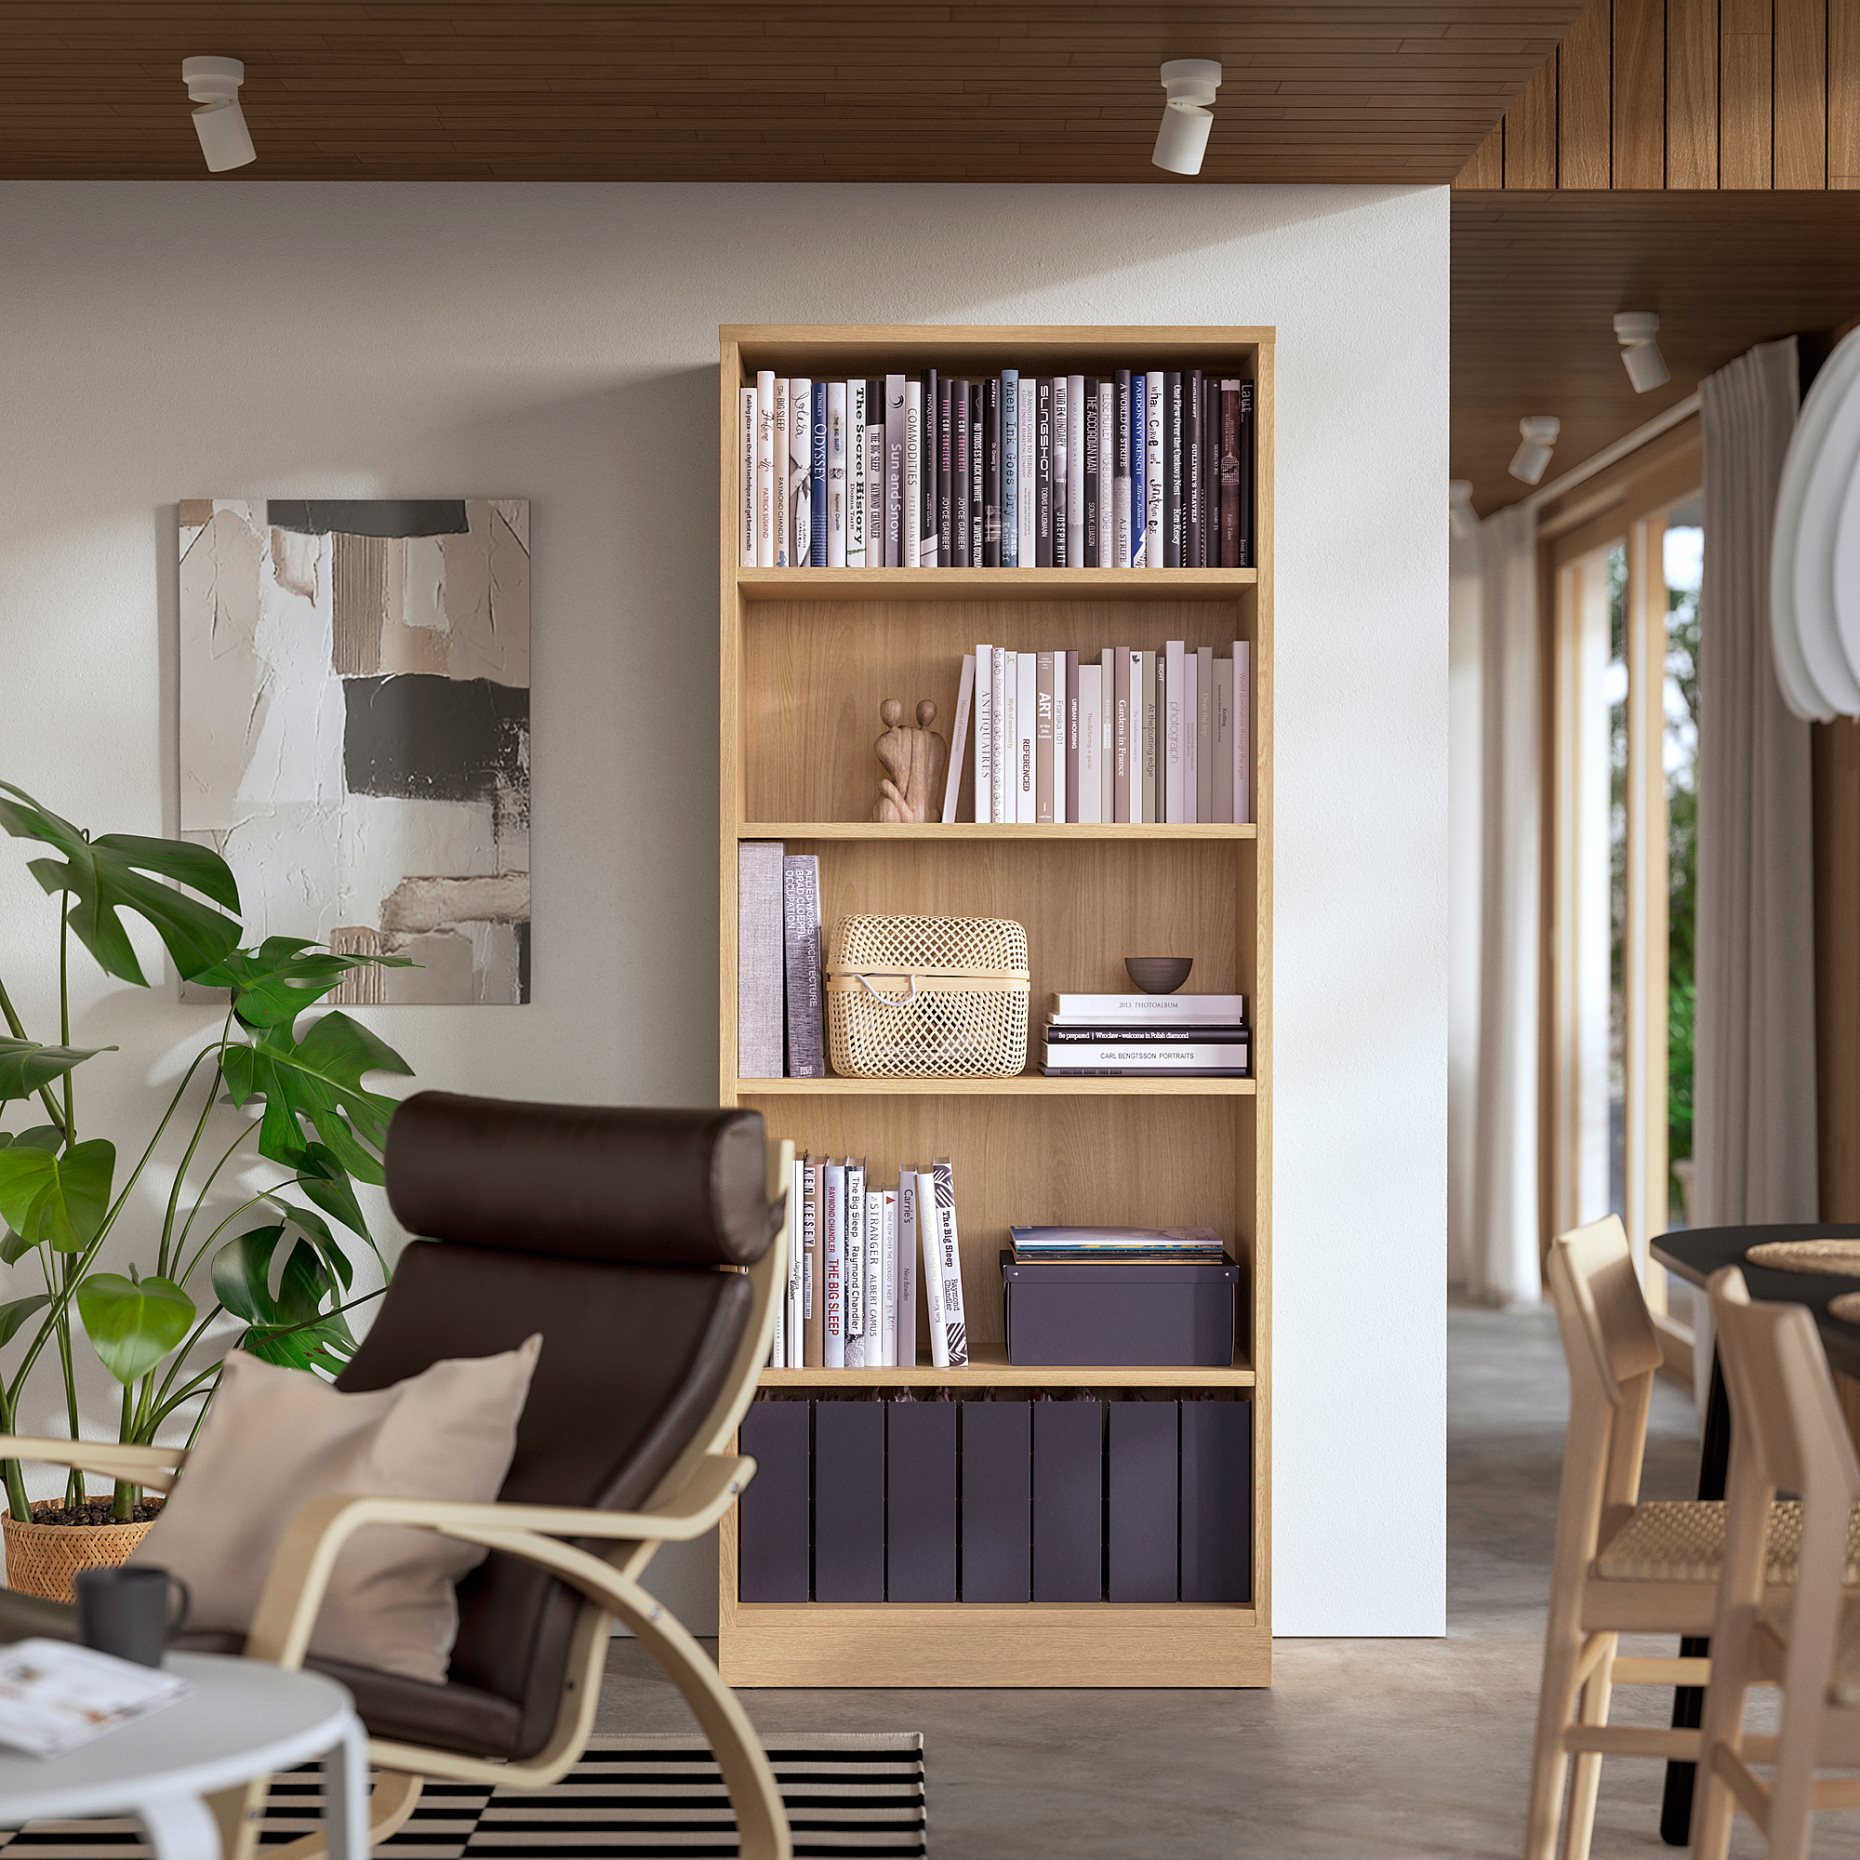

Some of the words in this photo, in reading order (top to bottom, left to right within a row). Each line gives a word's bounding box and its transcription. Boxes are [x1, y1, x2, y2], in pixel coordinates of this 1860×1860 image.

[856, 388, 864, 420] The
[1007, 381, 1016, 413] When
[1087, 396, 1097, 410] THE
[1174, 385, 1182, 399] One
[1120, 392, 1128, 423] WORLD
[1174, 400, 1182, 418] Flew
[871, 432, 880, 443] THE
[974, 423, 982, 431] NO
[1007, 422, 1016, 445] Ink
[1040, 385, 1049, 482] SLINGSHOT
[1120, 425, 1128, 437] OF
[1136, 422, 1142, 436] MY
[1174, 418, 1182, 436] Over
[814, 424, 827, 482] ODYSSEY
[856, 425, 864, 478] Secret
[871, 445, 880, 454] BIG
[908, 408, 918, 486] COMMODITIES
[1120, 438, 1128, 468] STRIFE
[1174, 437, 1182, 448] the
[871, 456, 880, 472] SLEEP
[891, 444, 902, 469] Sun
[974, 458, 982, 476] BLACK
[1007, 453, 1016, 485] Goes
[1087, 456, 1097, 474] MAN
[1174, 449, 1182, 479] Cuckoo's
[891, 474, 902, 499] and
[974, 476, 982, 484] OR
[1174, 479, 1182, 495] Nest
[871, 483, 880, 509] RAYMOND
[974, 485, 982, 502] WHITE
[1004, 494, 1016, 517] Dry
[854, 482, 864, 545] History
[942, 496, 950, 519] JOYCE
[1174, 508, 1182, 523] Ken
[871, 512, 880, 539] CHANDLER
[891, 504, 902, 542] Snow
[942, 522, 950, 550] GARBER
[1057, 512, 1065, 543] JOSEPH
[1172, 524, 1182, 545] Kesey
[1057, 546, 1065, 563] HITT
[1039, 692, 1051, 720] ART
[1056, 700, 1064, 730] Franska
[1148, 704, 1155, 713] At
[980, 690, 990, 778] ANTIQUAIRES
[1056, 732, 1064, 746] 101
[1119, 737, 1126, 746] in
[1168, 702, 1180, 763] photograph
[1238, 728, 1246, 752] through
[1023, 739, 1031, 792] REFERENCED
[1147, 758, 1155, 777] edge
[796, 869, 804, 895] BRAD
[806, 869, 814, 900] ALLIED
[786, 870, 795, 930] OCCUPATION
[797, 897, 806, 941] CLOEPFIL
[807, 902, 815, 936] WORKS
[808, 937, 817, 1007] ARCHITECTURE
[804, 1170, 814, 1193] KEN
[852, 1177, 860, 1194] The
[828, 1187, 836, 1218] RAYMOND
[850, 1196, 860, 1210] Big
[904, 1189, 913, 1223] Carrie's
[804, 1204, 814, 1245] KESEY
[850, 1212, 860, 1238] Sleep
[943, 1211, 951, 1227] The
[828, 1218, 836, 1253] CHANDLER
[870, 1203, 879, 1265] STRANGER
[943, 1229, 952, 1243] Big
[828, 1259, 839, 1279] THE
[850, 1246, 860, 1288] Raymond
[945, 1245, 954, 1268] Sleep
[828, 1282, 839, 1300] BIG
[944, 1280, 952, 1311] Chandler
[951, 1279, 960, 1311] Raymond
[828, 1303, 839, 1336] SLEEP
[852, 1291, 860, 1330] Chandler
